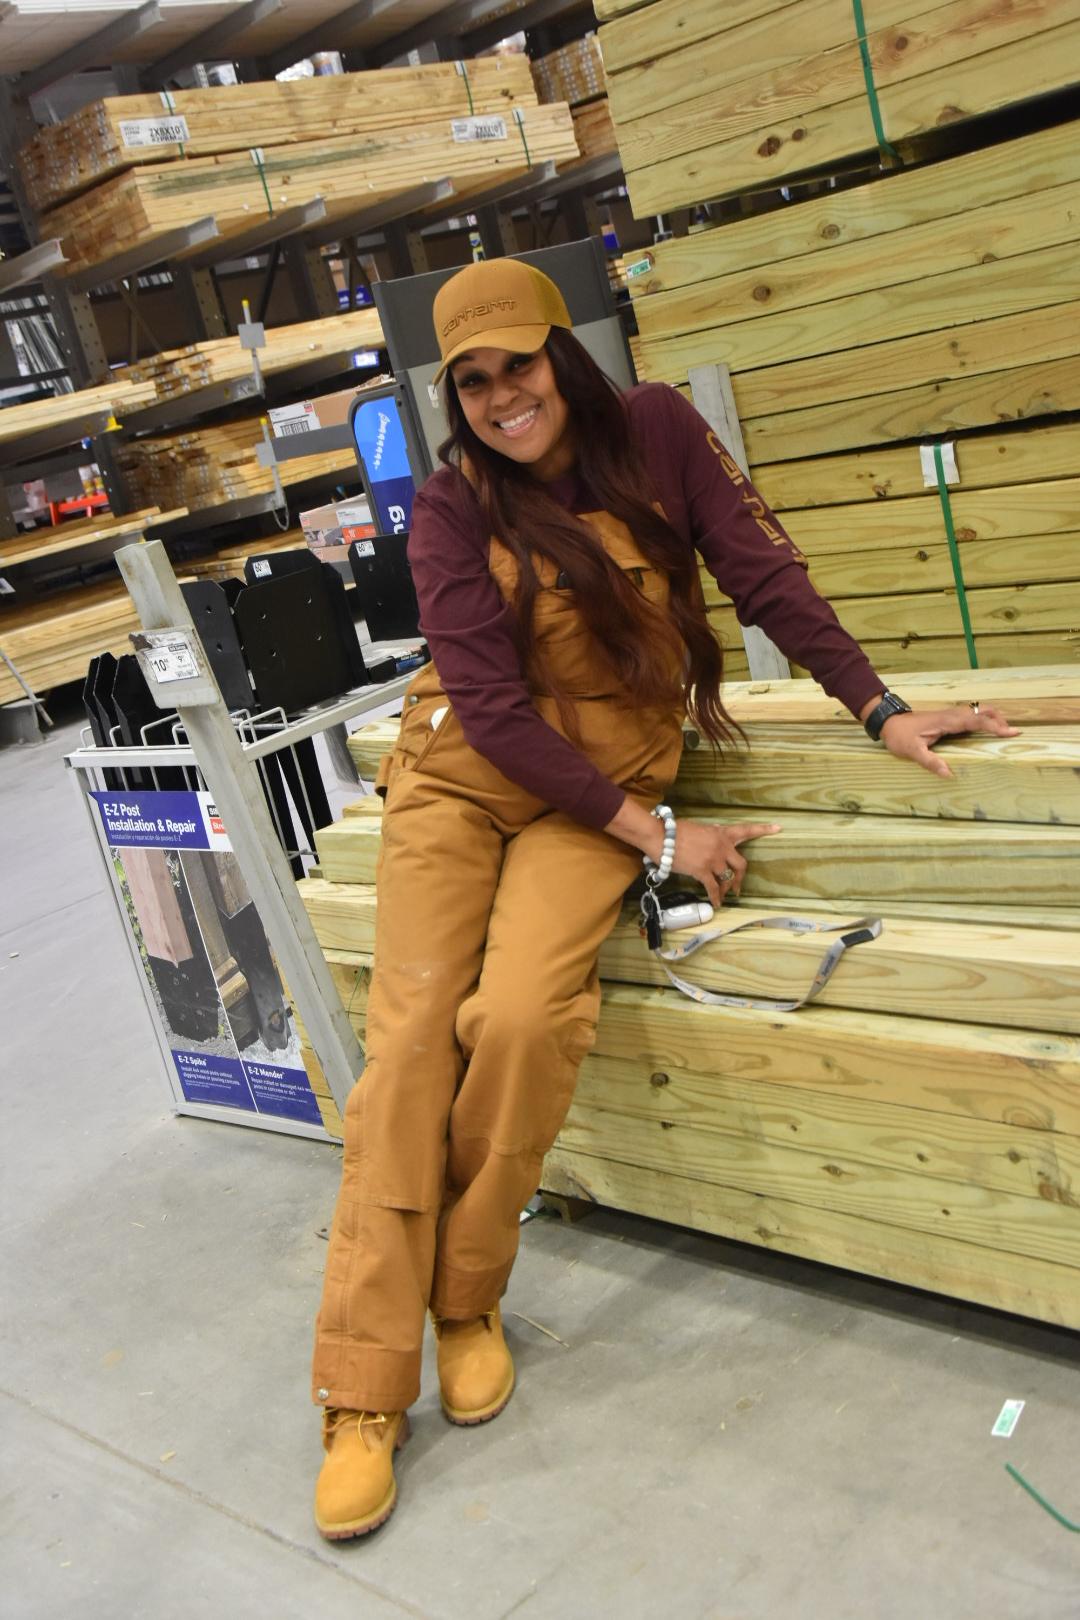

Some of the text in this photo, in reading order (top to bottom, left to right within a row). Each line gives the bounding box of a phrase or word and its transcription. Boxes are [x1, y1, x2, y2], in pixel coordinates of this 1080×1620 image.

[443, 298, 517, 336] carhartt
[103, 803, 141, 817] E-Z Post
[107, 818, 196, 835] Installation & Repair
[178, 1055, 190, 1064] E-Z
[247, 1066, 260, 1075] E-Z
